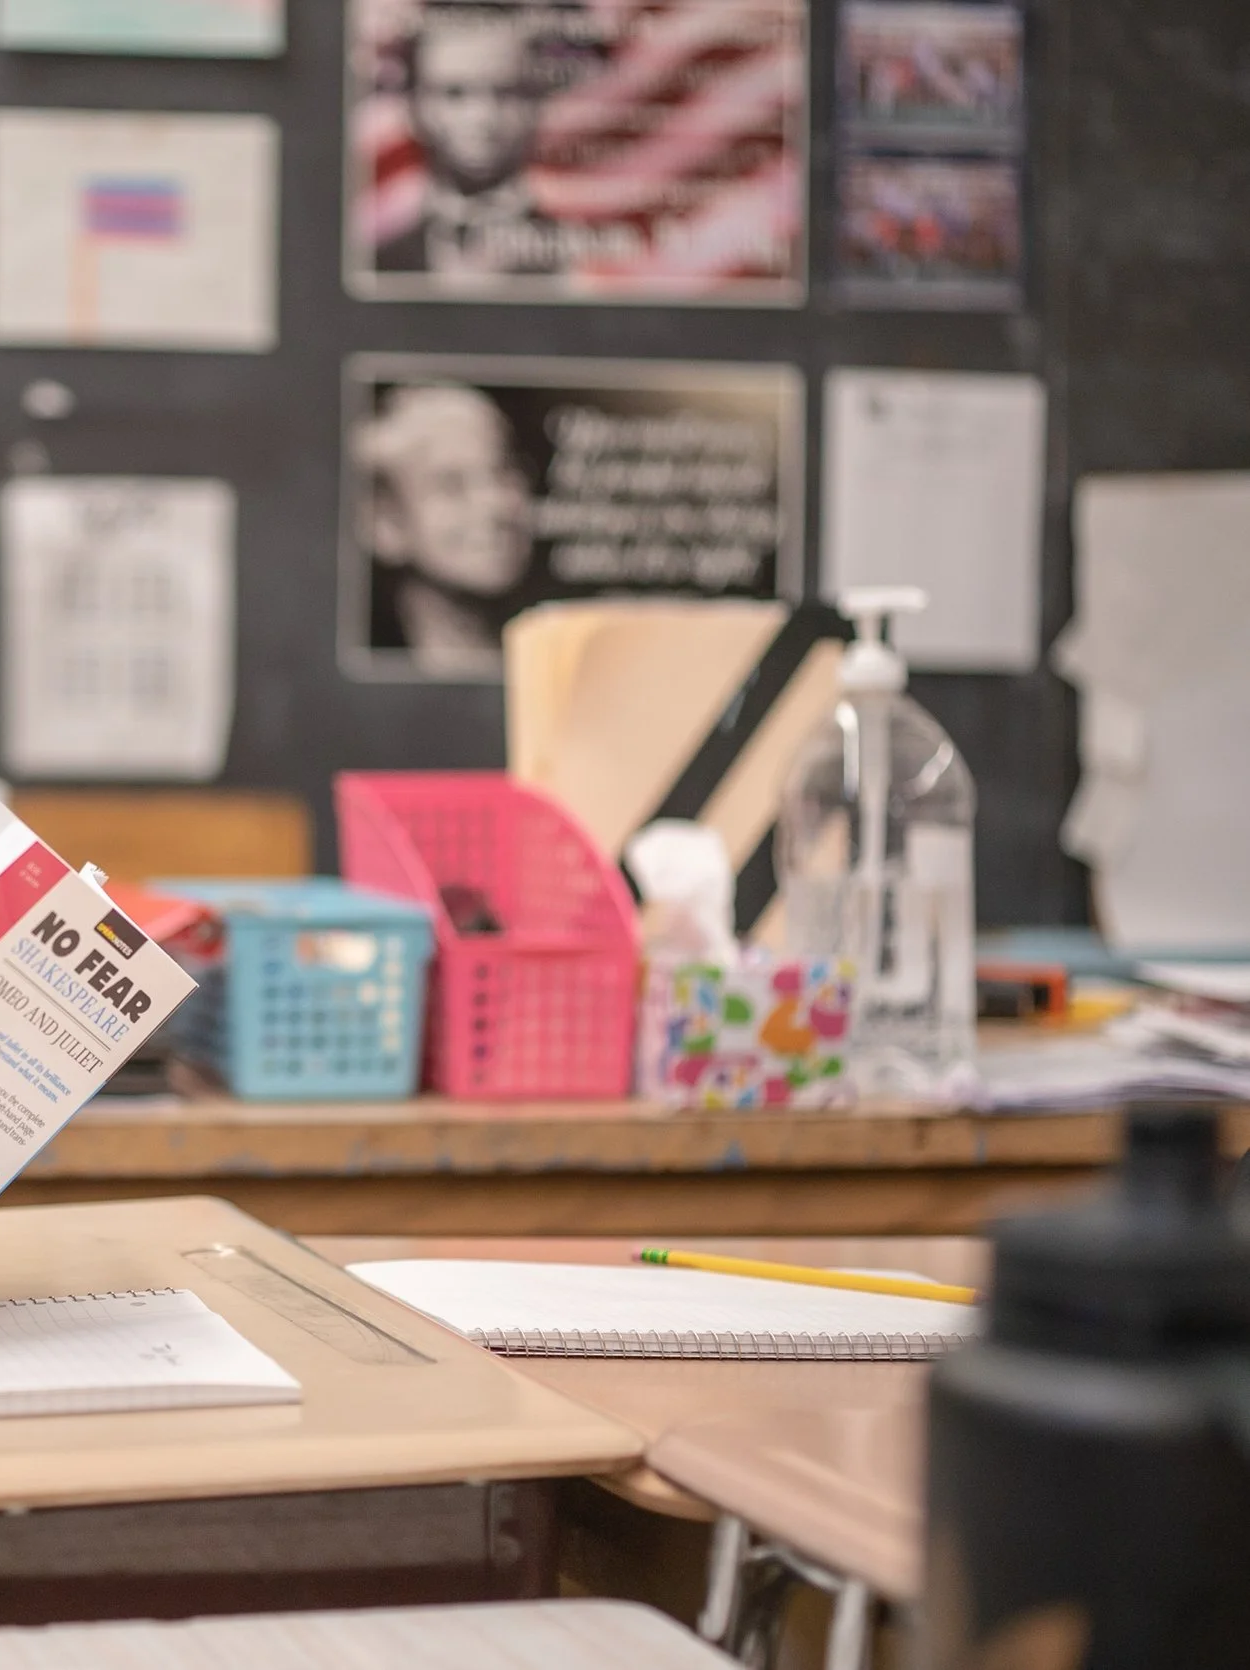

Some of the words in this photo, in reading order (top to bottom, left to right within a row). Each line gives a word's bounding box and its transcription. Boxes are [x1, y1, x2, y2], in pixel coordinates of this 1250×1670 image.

[32, 911, 79, 957] NO
[75, 949, 152, 1024] FEAR
[11, 939, 130, 1043] SHAKESPEARE
[24, 1007, 58, 1036] AND
[51, 1030, 104, 1074] JULIET
[18, 1065, 34, 1081] what
[32, 1077, 39, 1085] it
[38, 1083, 59, 1103] means.
[28, 1055, 38, 1066] all
[35, 1062, 46, 1073] its
[43, 1069, 73, 1096] brilliance
[8, 1094, 20, 1106] the
[16, 1101, 47, 1130] complete
[9, 1130, 27, 1147] trans-
